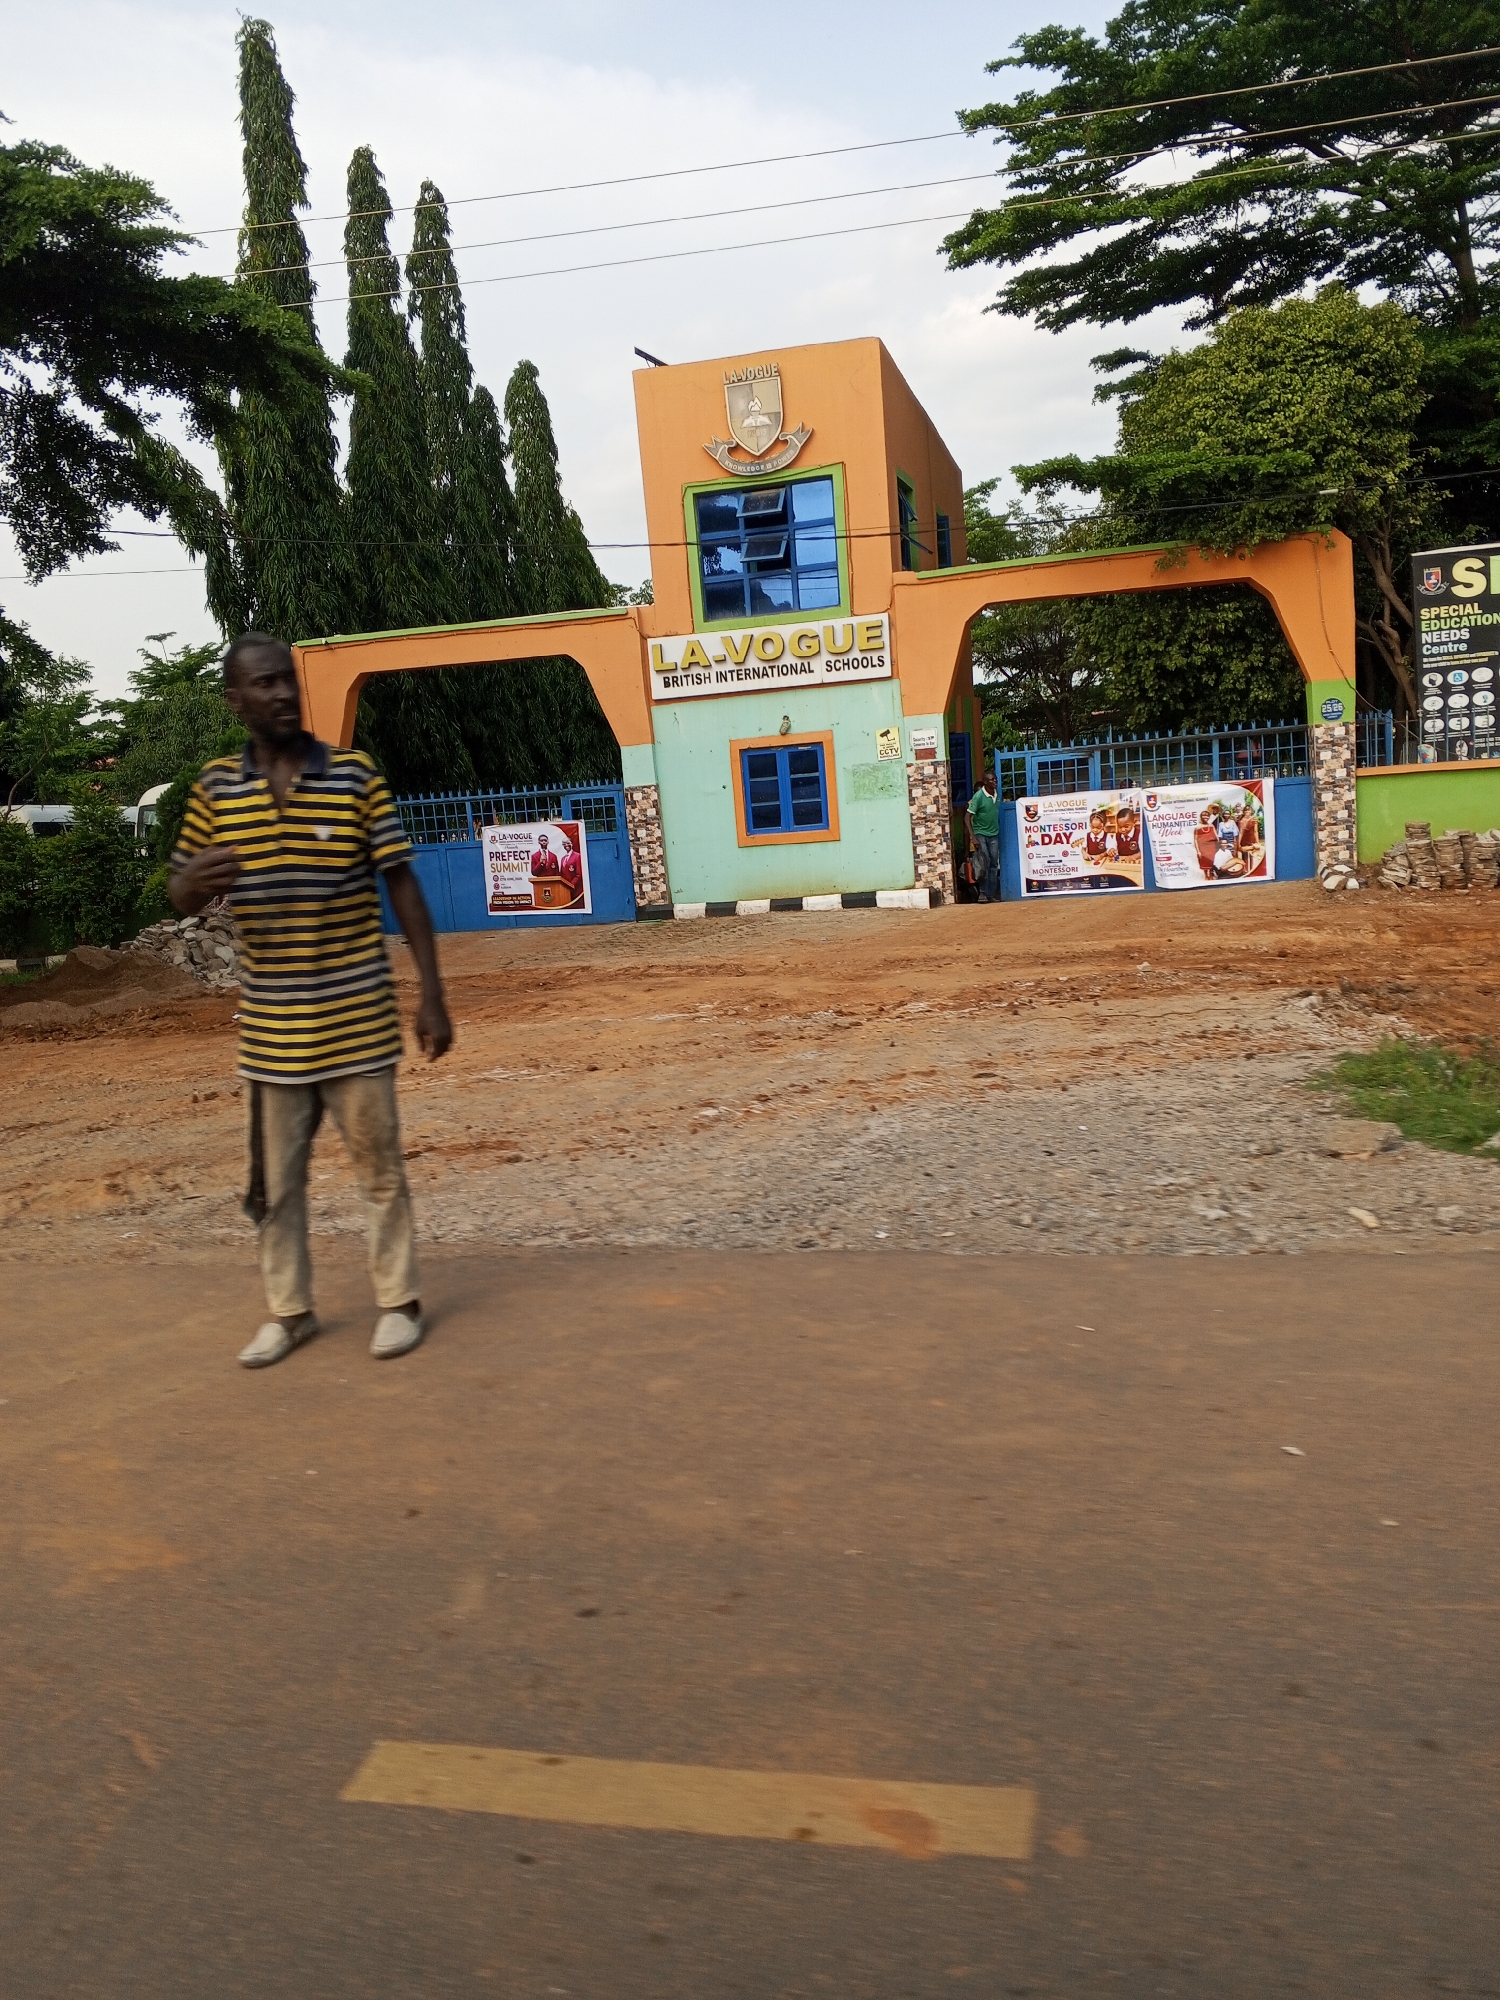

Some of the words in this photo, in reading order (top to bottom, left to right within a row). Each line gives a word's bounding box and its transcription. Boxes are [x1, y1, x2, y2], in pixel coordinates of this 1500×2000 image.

[723, 363, 780, 384] LA-VOGUE
[724, 459, 764, 472] KNOWLEDGE
[773, 449, 795, 467] POWER
[1420, 602, 1483, 620] SPECIAL
[1421, 612, 1500, 632] EDUCATION
[1421, 628, 1470, 644] NEEDS
[651, 619, 885, 673] LA-VOGUE
[1422, 642, 1468, 655] Centre
[663, 671, 712, 689] BRITISH
[715, 661, 815, 684] INTERNATIONAL
[825, 655, 885, 673] SCHOOLS
[879, 747, 899, 756] CCTV
[1042, 799, 1087, 809] LA-VOGUE
[1147, 811, 1197, 823] LANGUAGE
[1025, 821, 1087, 834] MONTESSORI
[1151, 819, 1198, 829] HUMANITIES
[499, 833, 533, 841] LA-VOGUE
[1040, 831, 1074, 846] DAY
[1158, 827, 1182, 838] Week
[489, 850, 531, 862] PREFECT
[490, 861, 530, 873] SUMMIT
[1032, 866, 1079, 875] MONTESSORI
